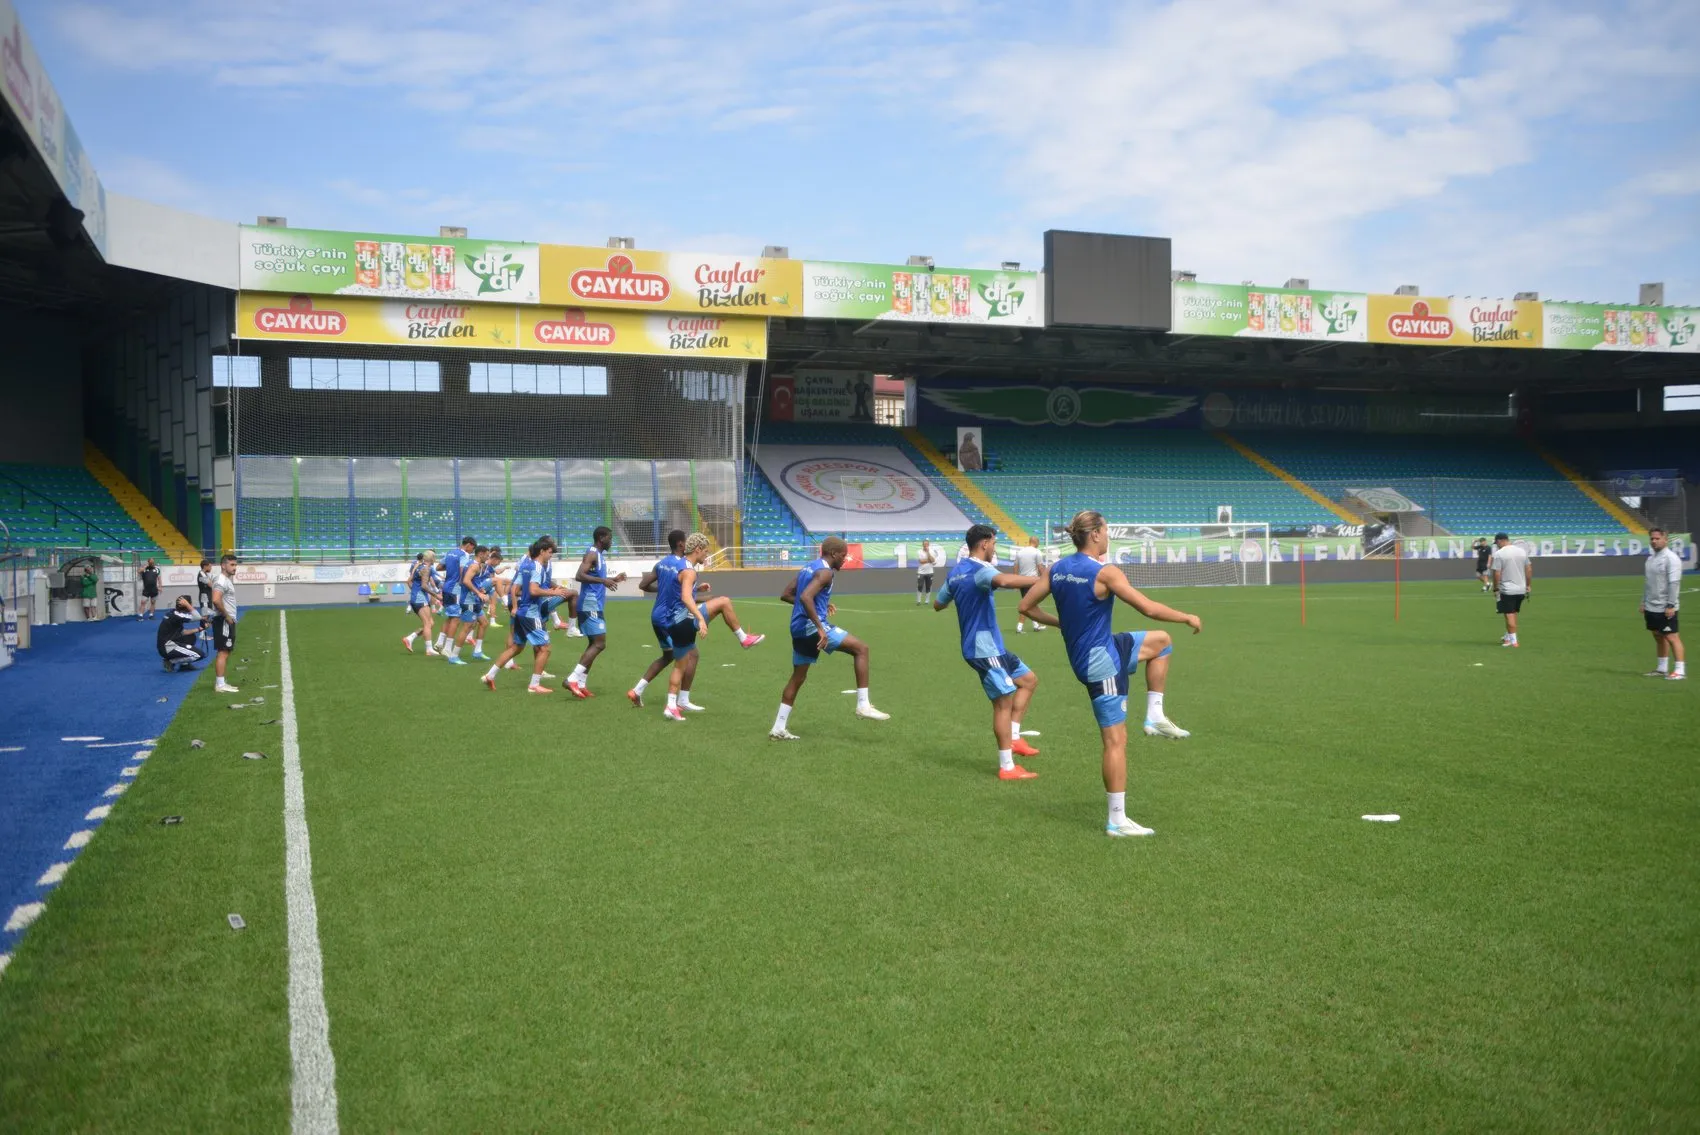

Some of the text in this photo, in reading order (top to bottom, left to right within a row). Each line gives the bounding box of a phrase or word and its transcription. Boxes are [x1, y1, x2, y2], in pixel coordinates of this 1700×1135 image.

[252, 243, 347, 259] Türkiye'nin
[255, 259, 346, 276] soğuk çayı
[577, 275, 664, 297] ÇAYKUR
[694, 262, 766, 293] Çaylar
[813, 276, 886, 289] Türkiye'nin
[697, 285, 769, 308] Bizden
[815, 289, 885, 303] soğuk çayı
[261, 312, 341, 331] ÇAYKUR
[405, 303, 470, 326] Çaylar
[1220, 312, 1242, 321] çayı
[408, 321, 478, 339] Bizden
[540, 325, 610, 342] ÇAYKUR
[1392, 318, 1450, 335] ÇAYKUR
[1473, 324, 1521, 343] Bizden
[670, 333, 731, 350] Bizden
[1541, 535, 1684, 558] RİZESPR
